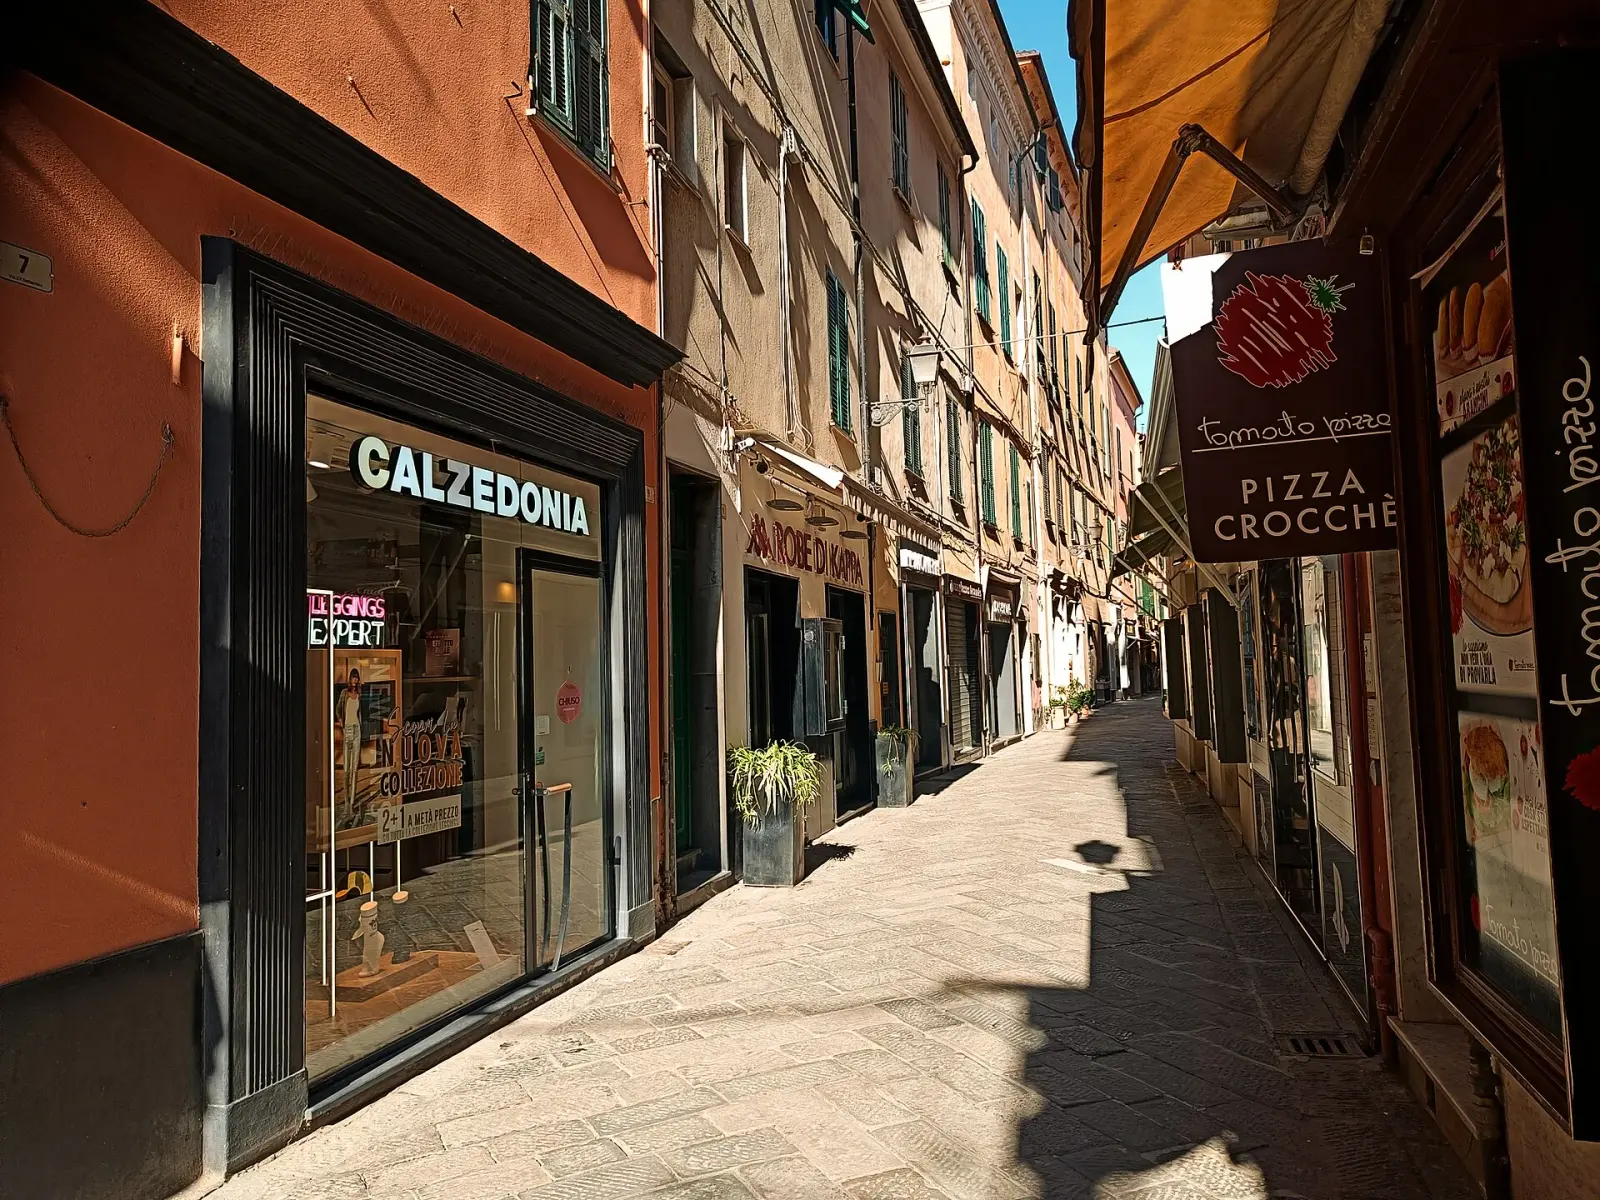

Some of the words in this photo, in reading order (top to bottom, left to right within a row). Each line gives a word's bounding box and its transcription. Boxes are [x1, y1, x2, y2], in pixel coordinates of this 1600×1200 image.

[18, 253, 29, 273] 7
[1197, 411, 1315, 450] tomato
[1323, 412, 1391, 443] pizza
[1555, 356, 1600, 493] pizza
[355, 436, 590, 536] CALZEDONIA
[1241, 468, 1366, 504] PIZZA
[1214, 493, 1398, 541] CROCCHÈ
[773, 521, 813, 572] ROBE
[814, 537, 828, 576] DI
[830, 543, 864, 585] KAPPA
[308, 594, 385, 618] LEGGINGS
[309, 619, 384, 646] EXPERT
[558, 697, 580, 706] CHIUSO
[388, 706, 438, 743] Scopri
[382, 731, 463, 767] NUOVA
[380, 763, 464, 797] COLLEZIONE
[408, 814, 413, 826] A
[415, 809, 432, 826] METÀ
[435, 806, 459, 821] PREZZO
